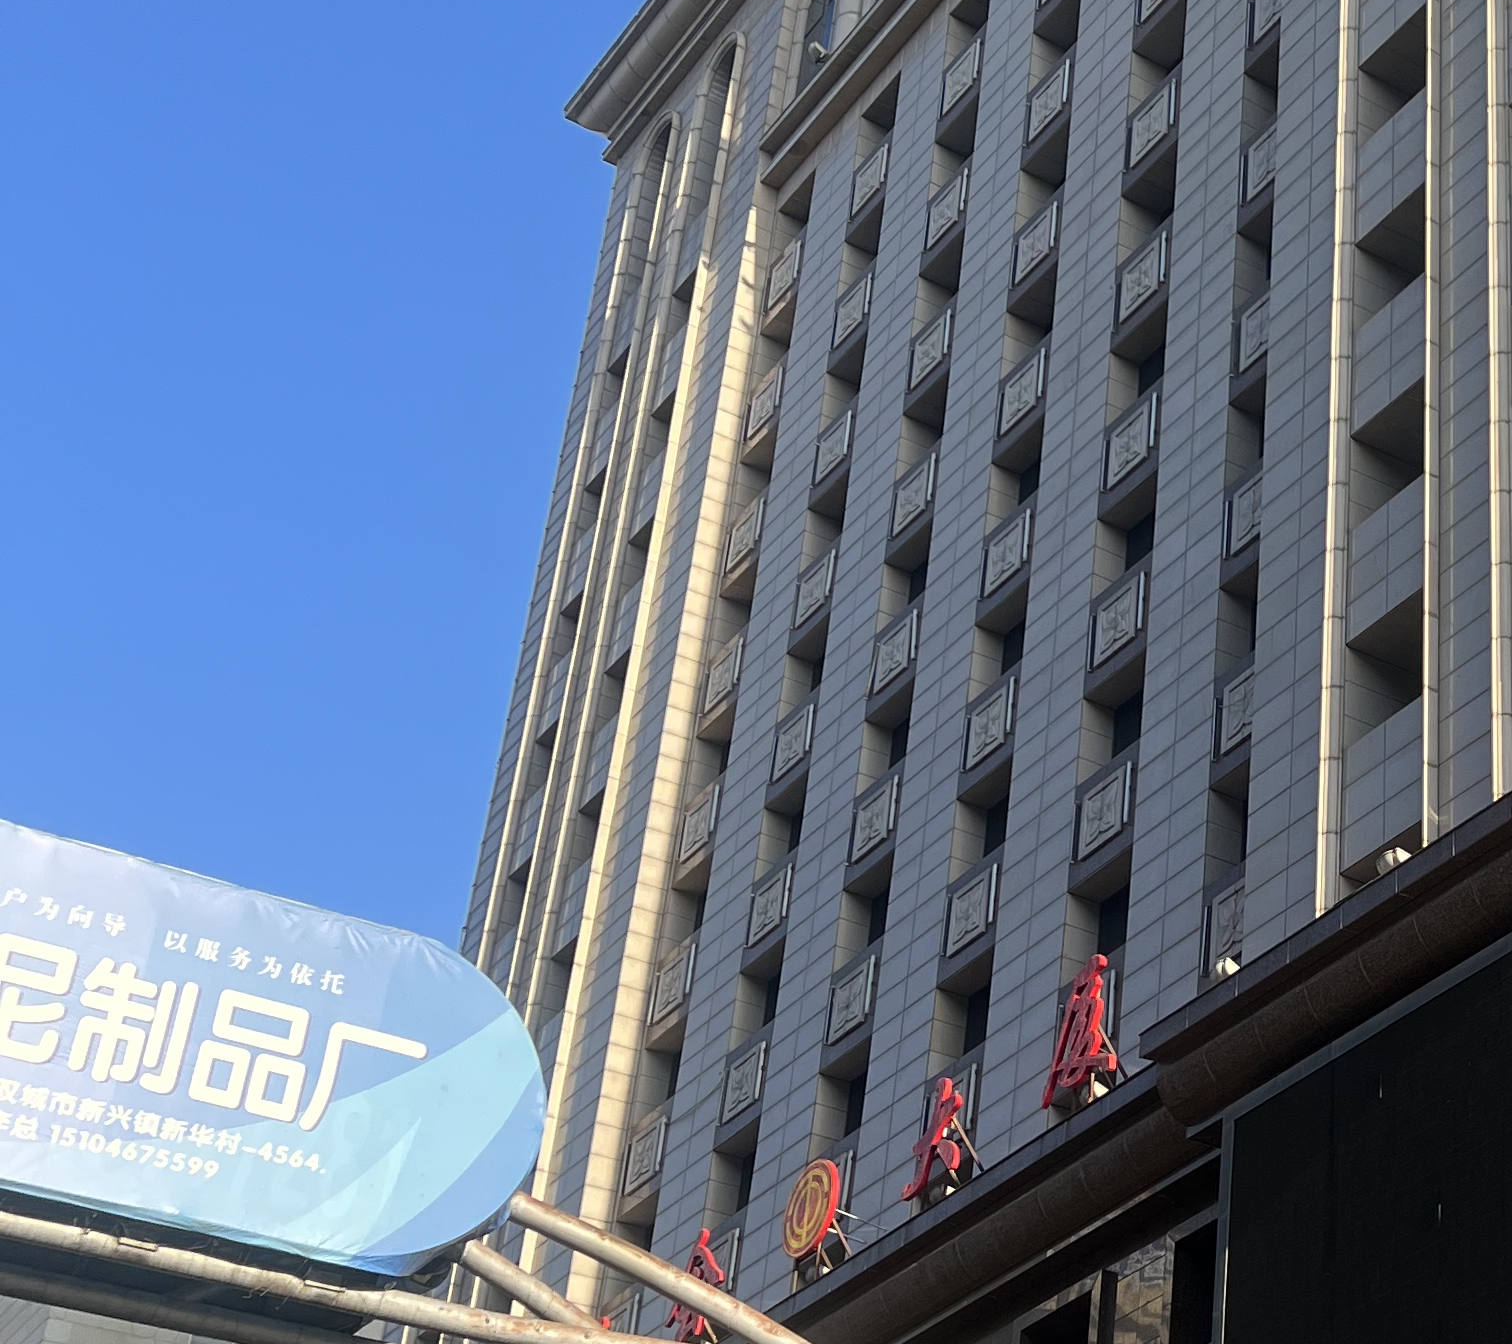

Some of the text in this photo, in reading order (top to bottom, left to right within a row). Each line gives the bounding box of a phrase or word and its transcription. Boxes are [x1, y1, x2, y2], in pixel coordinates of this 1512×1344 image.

[1, 887, 346, 995] 户为向导 以服务为依托
[50, 1124, 220, 1179] 15104675599
